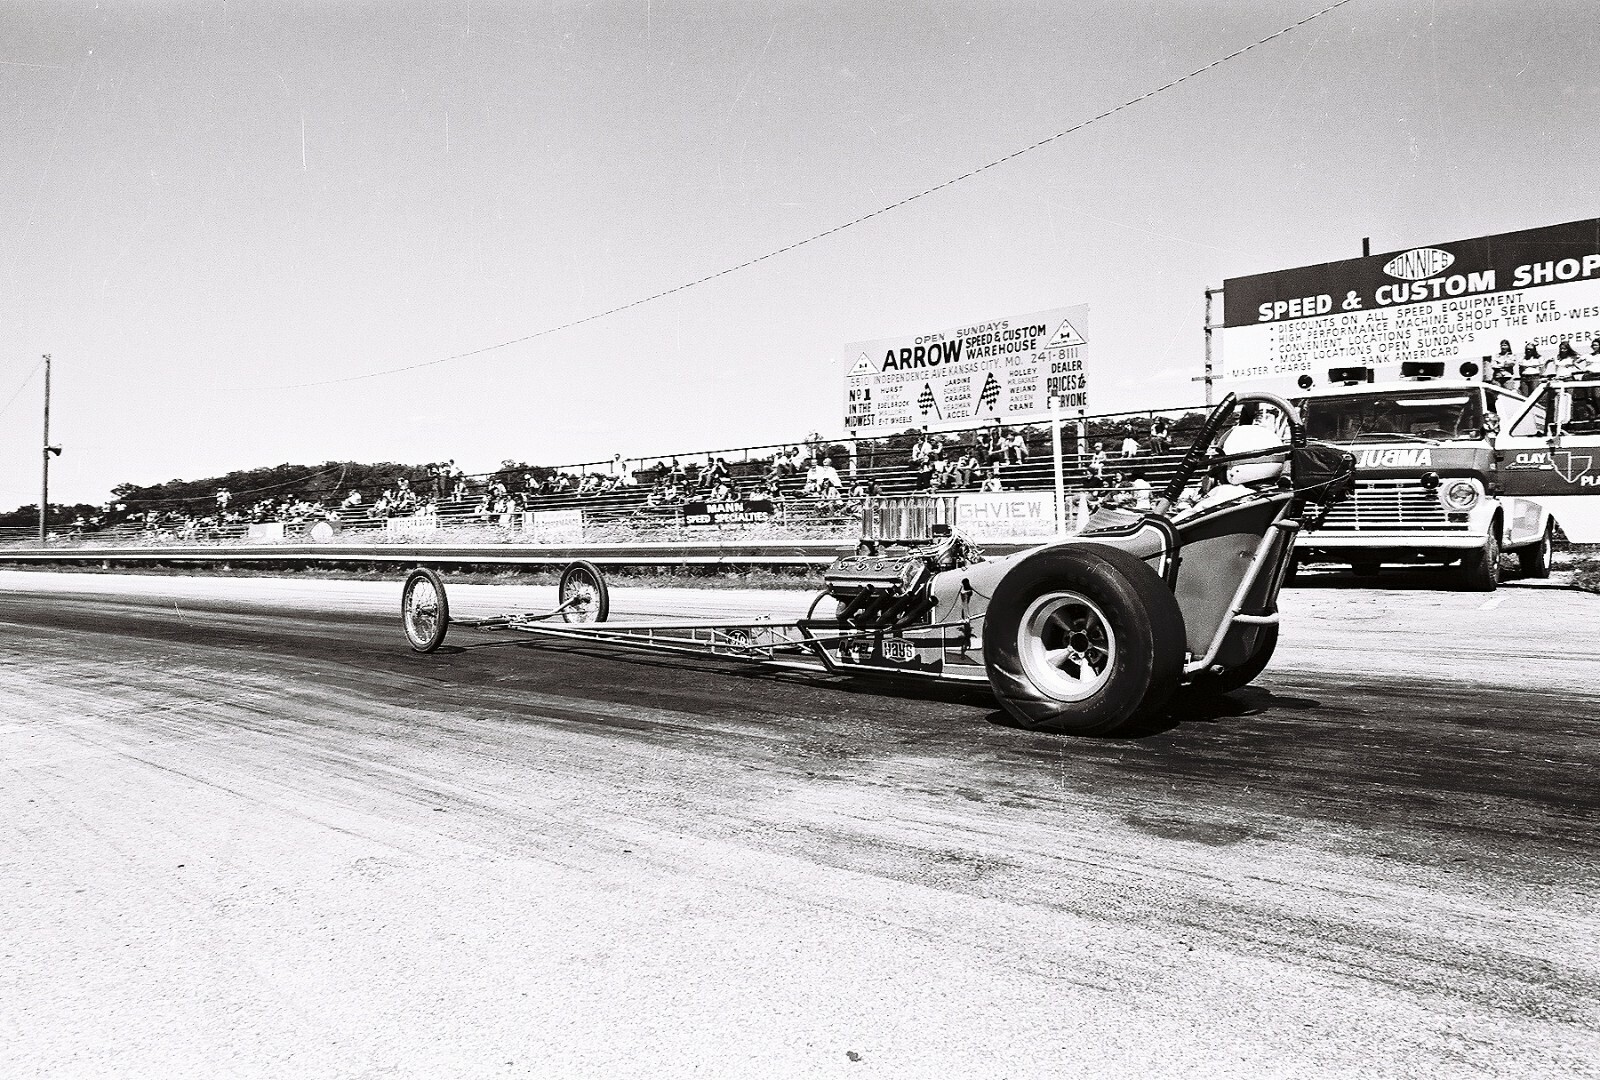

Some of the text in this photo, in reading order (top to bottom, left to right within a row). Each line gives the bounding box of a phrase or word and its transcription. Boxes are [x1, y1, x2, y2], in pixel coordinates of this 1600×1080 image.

[1389, 249, 1449, 278] RONNIE'S
[1258, 253, 1600, 322] SPEED & CUSTOM SHOP
[1278, 293, 1523, 334] DISCOUNTS ON ALL SPEED EQUIPMENT
[1278, 299, 1556, 343] HIGH PERFORMANCE MACHINE SHOP SERVICE
[914, 320, 1009, 345] OPEN SUNDAYS
[1278, 337, 1342, 353] CONVENIENT
[1348, 329, 1411, 345] LOCATIONS
[1417, 318, 1499, 337] THROUGHOUT
[1505, 315, 1528, 327] THE
[881, 324, 1046, 372] ARROW SPEED & CUSTOM
[966, 338, 1036, 360] WAREHOUSE
[1279, 332, 1475, 363] MOST LOCATIONS OPEN SUNDAYS
[1361, 346, 1459, 365] BANK AMERICARD
[873, 370, 929, 385] INDEPENDENCE
[948, 362, 979, 375] KANSAS
[1031, 347, 1078, 363] 241-8111
[1009, 367, 1037, 377] HOLLEY
[1051, 360, 1082, 374] DEALER
[1232, 362, 1311, 377] MASTER CHARGE
[880, 385, 903, 394] HURST
[1009, 384, 1037, 393] WEIAND
[1047, 374, 1077, 393] PRICES
[863, 388, 871, 401] 1
[944, 393, 972, 403] CRAGAR
[1047, 392, 1087, 409] ERYONE
[849, 402, 871, 414] IN THE
[1008, 402, 1034, 411] CRANE
[845, 413, 876, 427] MIDWEST
[947, 410, 970, 419] ACCEL
[1515, 453, 1547, 464] CLAY
[706, 502, 744, 513] MANN
[686, 512, 770, 524] SPEED SPECIALTIES
